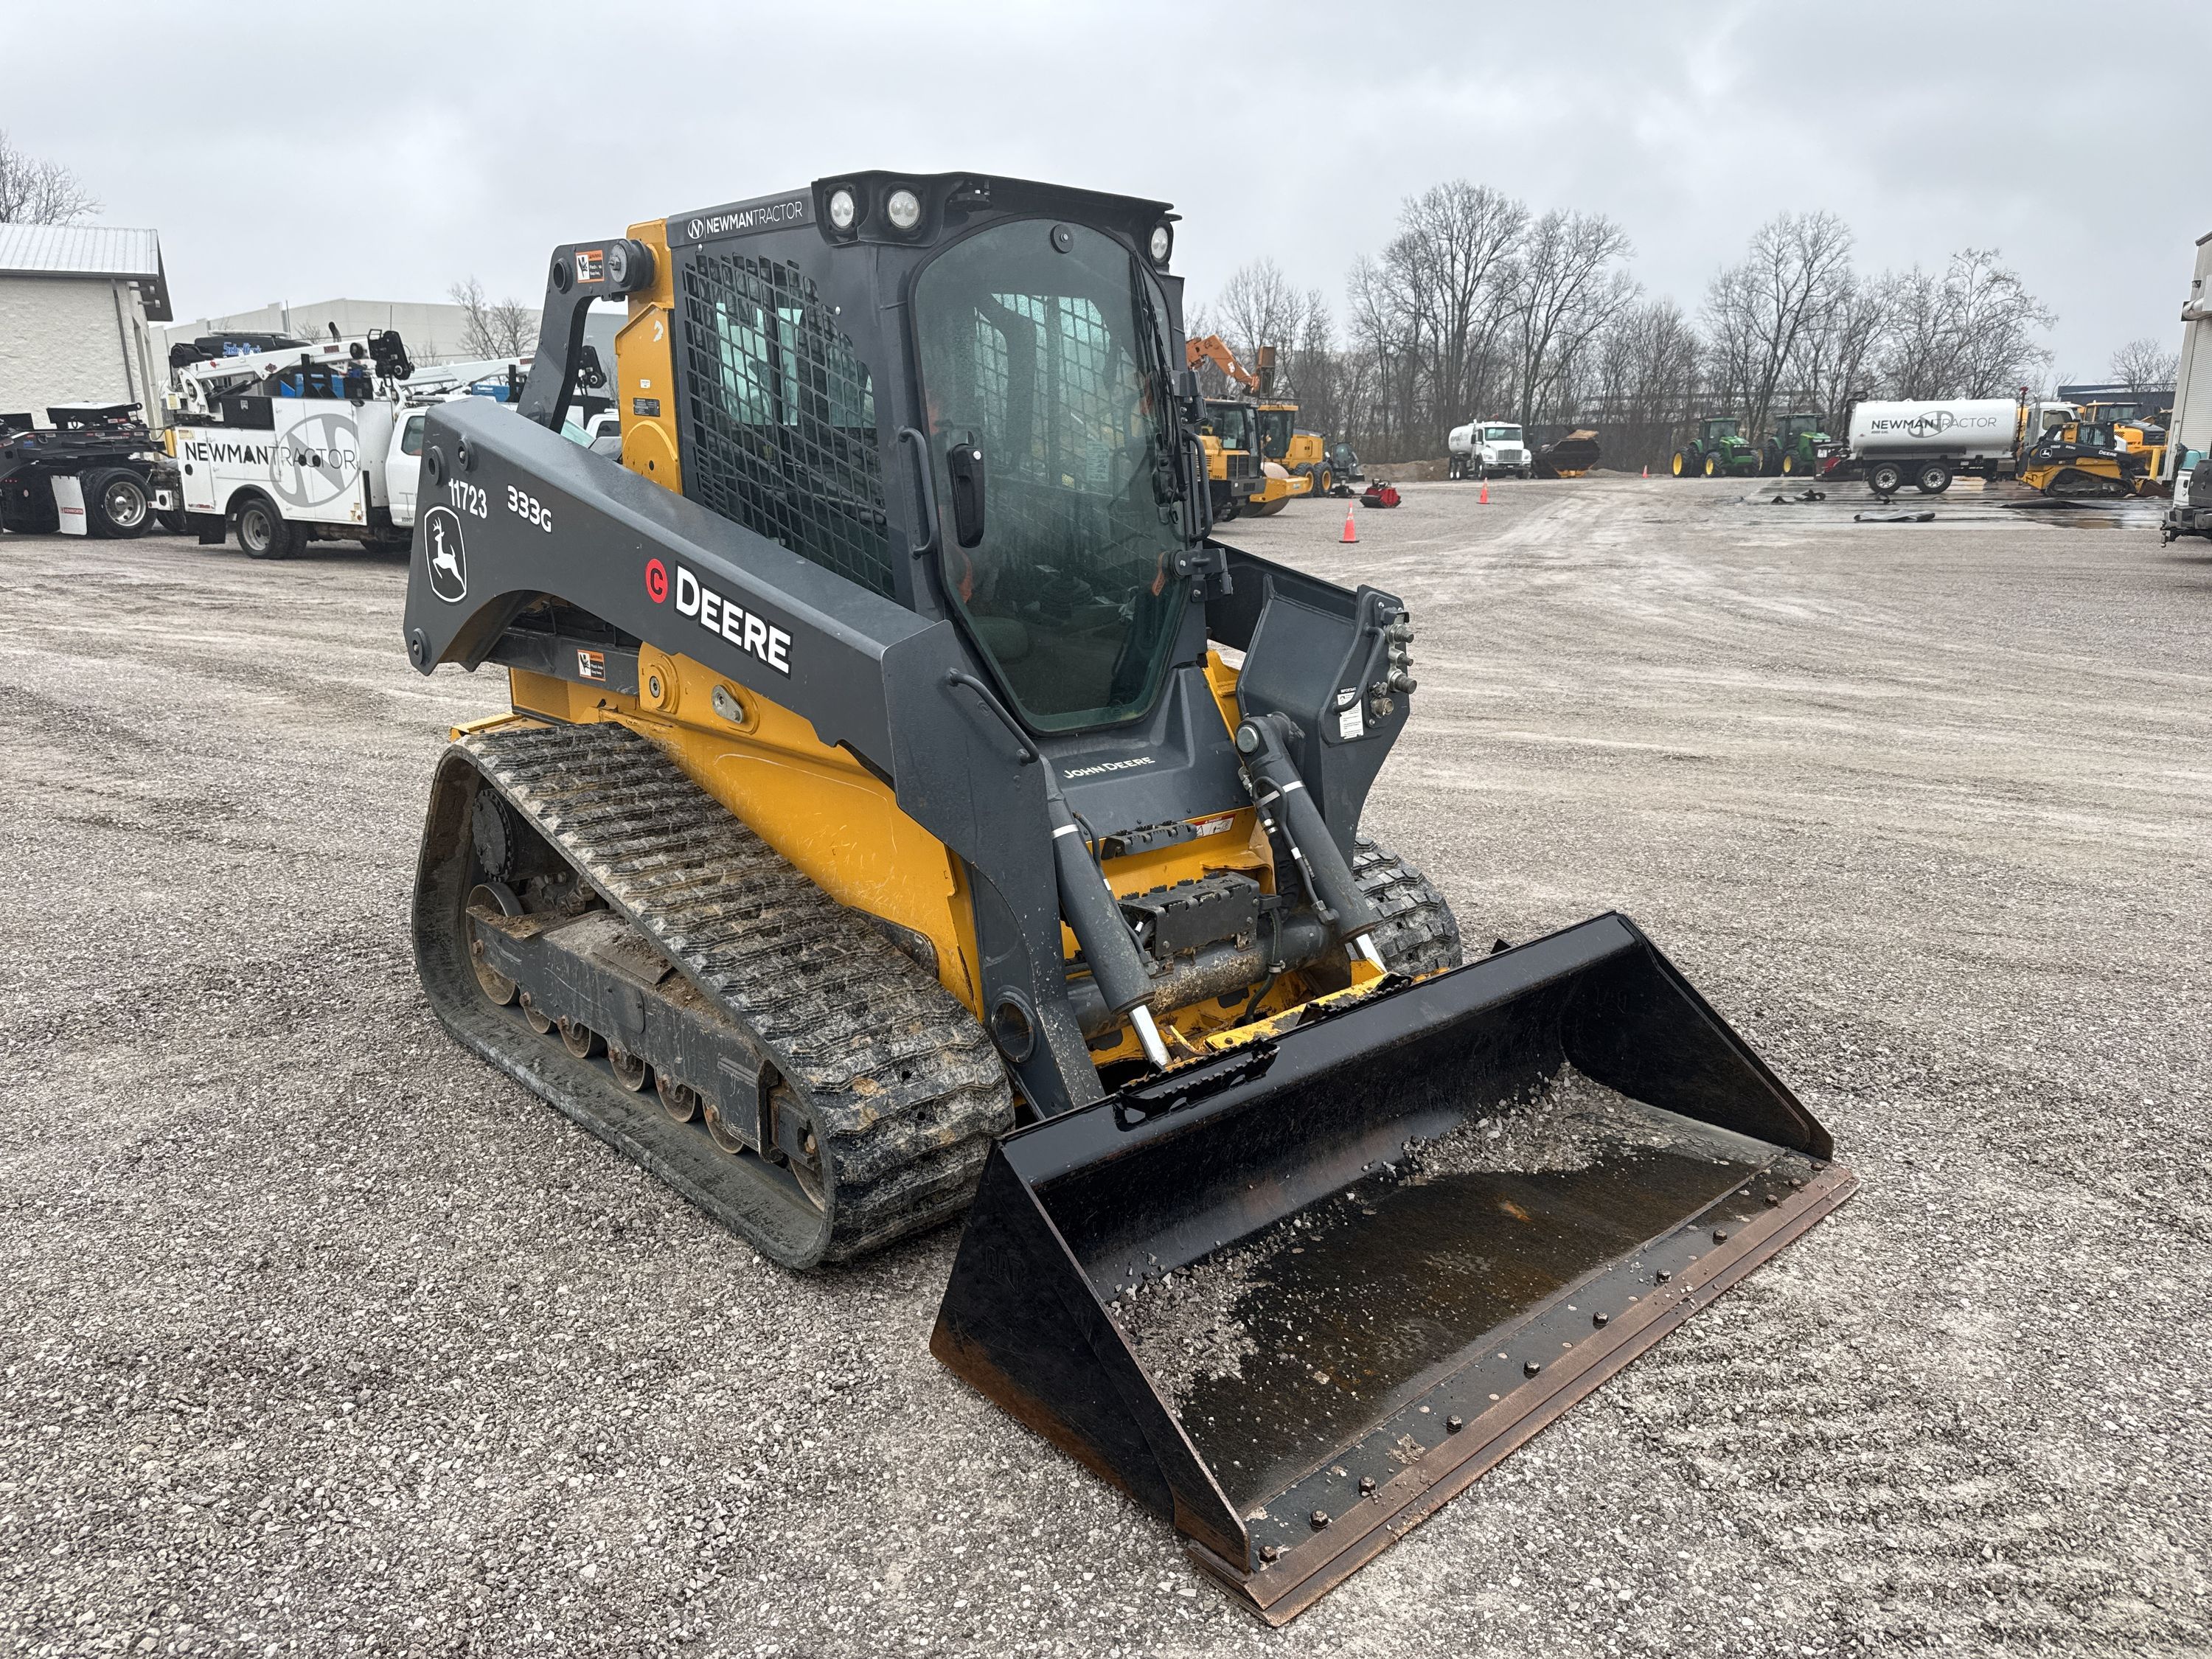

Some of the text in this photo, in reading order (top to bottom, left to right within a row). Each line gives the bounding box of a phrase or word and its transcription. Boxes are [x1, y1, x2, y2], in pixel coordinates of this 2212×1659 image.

[448, 478, 487, 519] 11723
[507, 484, 552, 532] 333G
[676, 566, 791, 674] DEERE
[1063, 757, 1155, 779] JOHN DEERE
